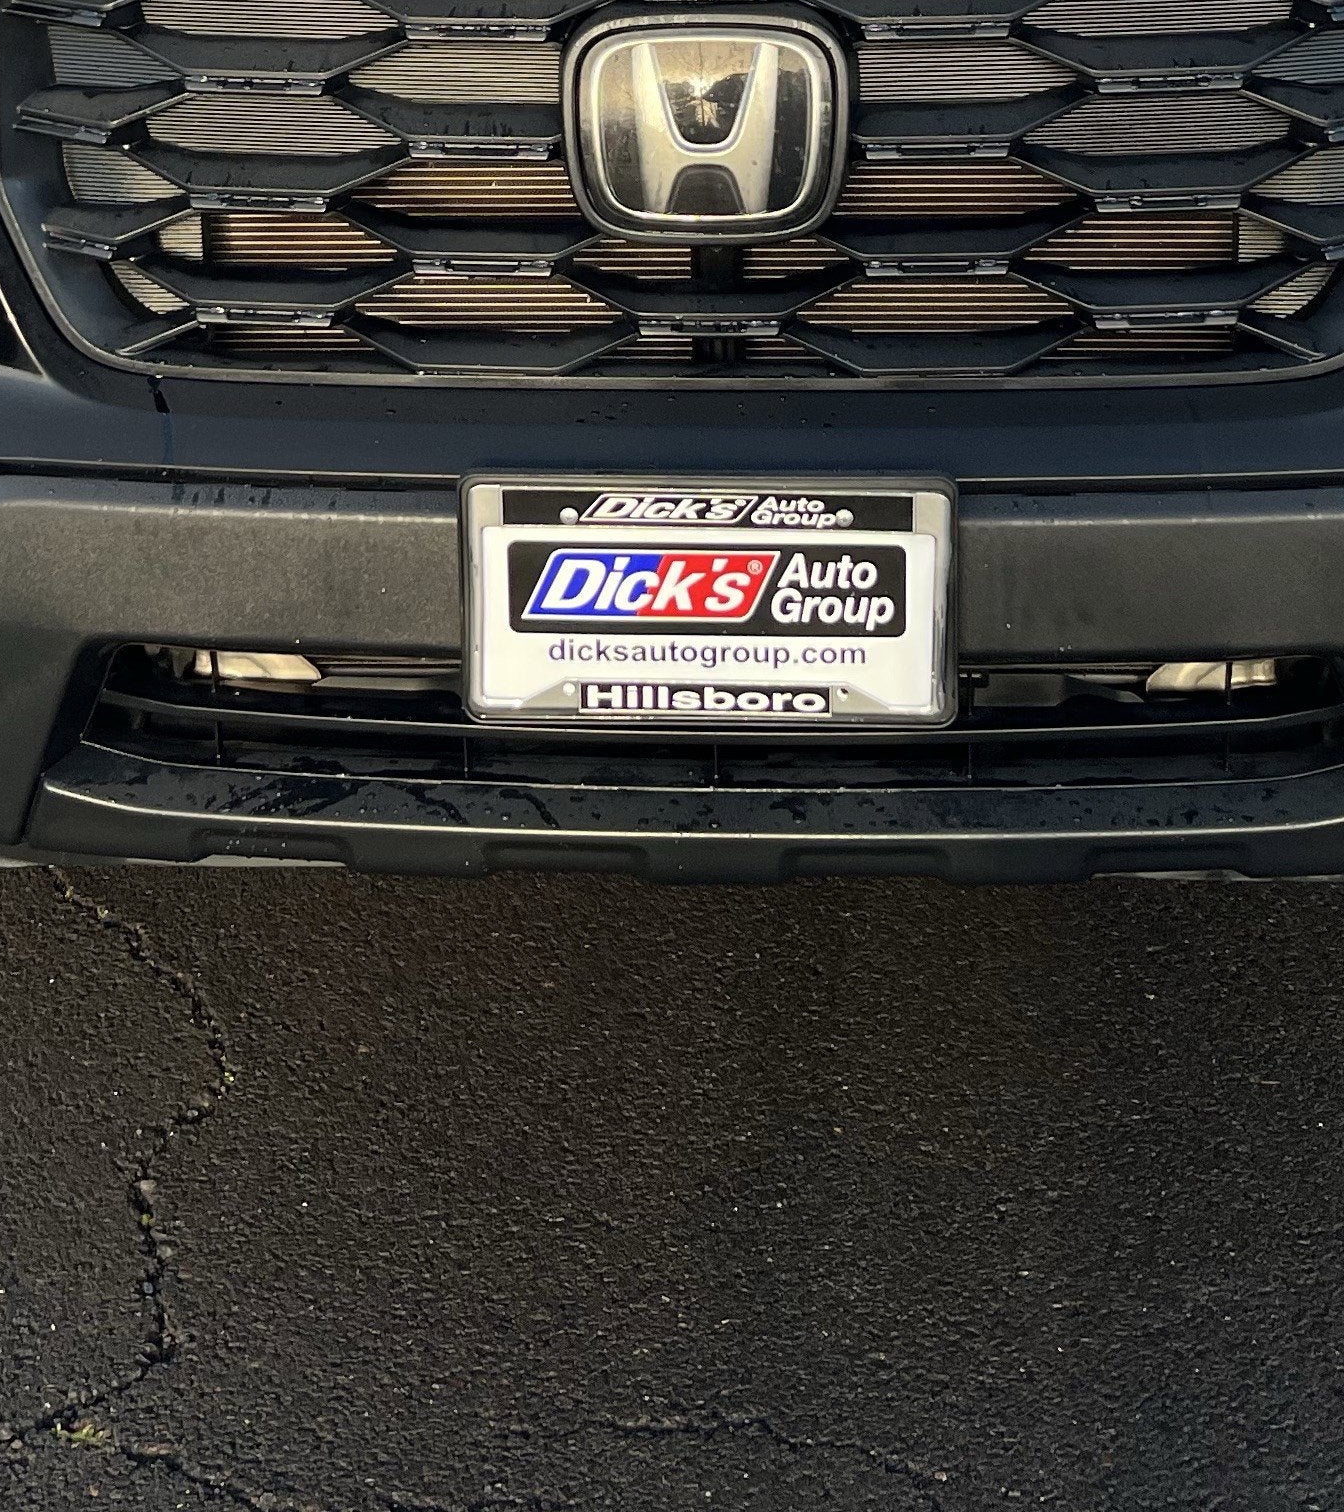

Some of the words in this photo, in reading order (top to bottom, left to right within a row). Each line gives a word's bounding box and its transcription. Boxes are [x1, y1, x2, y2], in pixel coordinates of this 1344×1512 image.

[593, 496, 738, 520] Dick's
[750, 509, 837, 528] Group
[757, 496, 825, 512] Auto
[541, 555, 752, 612] Dick's
[777, 552, 878, 590] Auto
[771, 589, 895, 631] Group
[548, 638, 866, 669] dicksautogroup.com
[587, 685, 827, 713] Hillsboro
